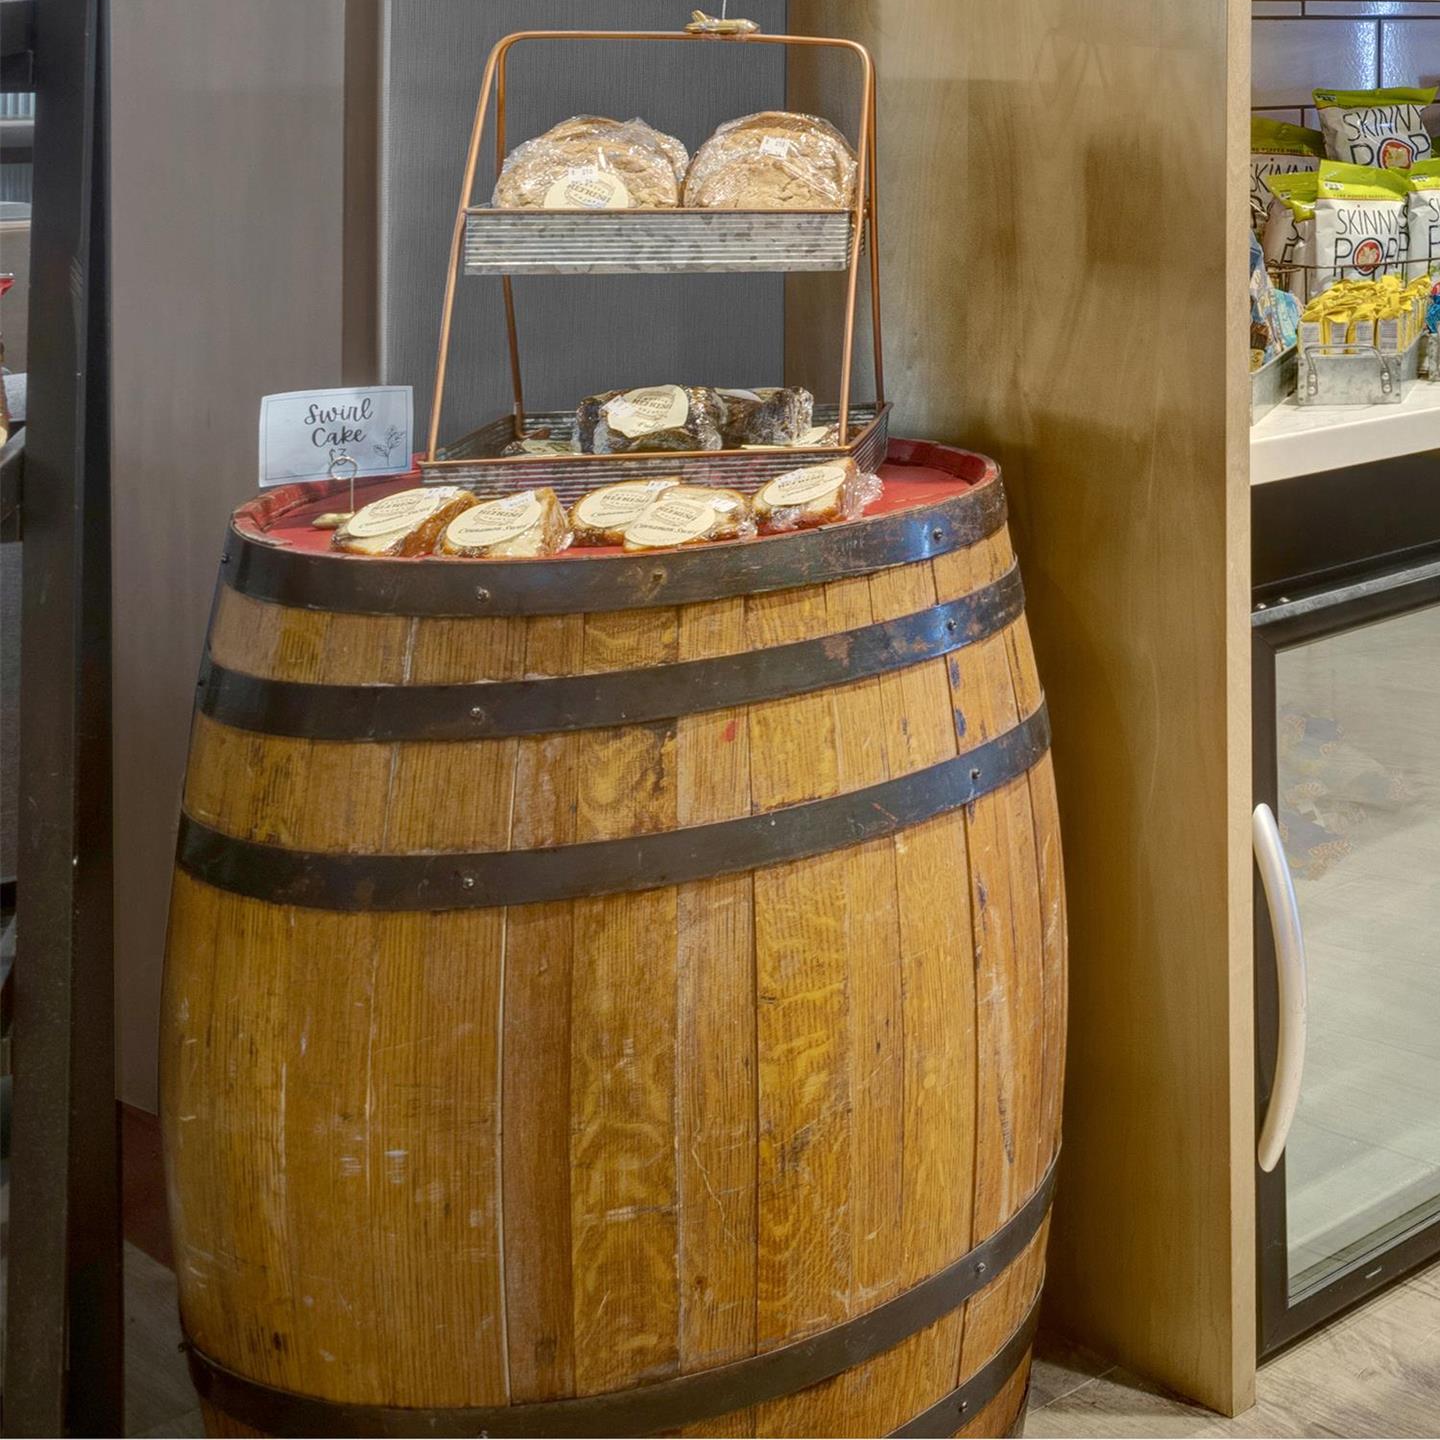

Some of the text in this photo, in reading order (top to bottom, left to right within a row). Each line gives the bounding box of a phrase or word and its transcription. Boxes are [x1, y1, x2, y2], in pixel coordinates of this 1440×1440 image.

[1336, 204, 1401, 235] SKINNY
[304, 397, 374, 425] Swirl
[312, 426, 367, 448] Cake
